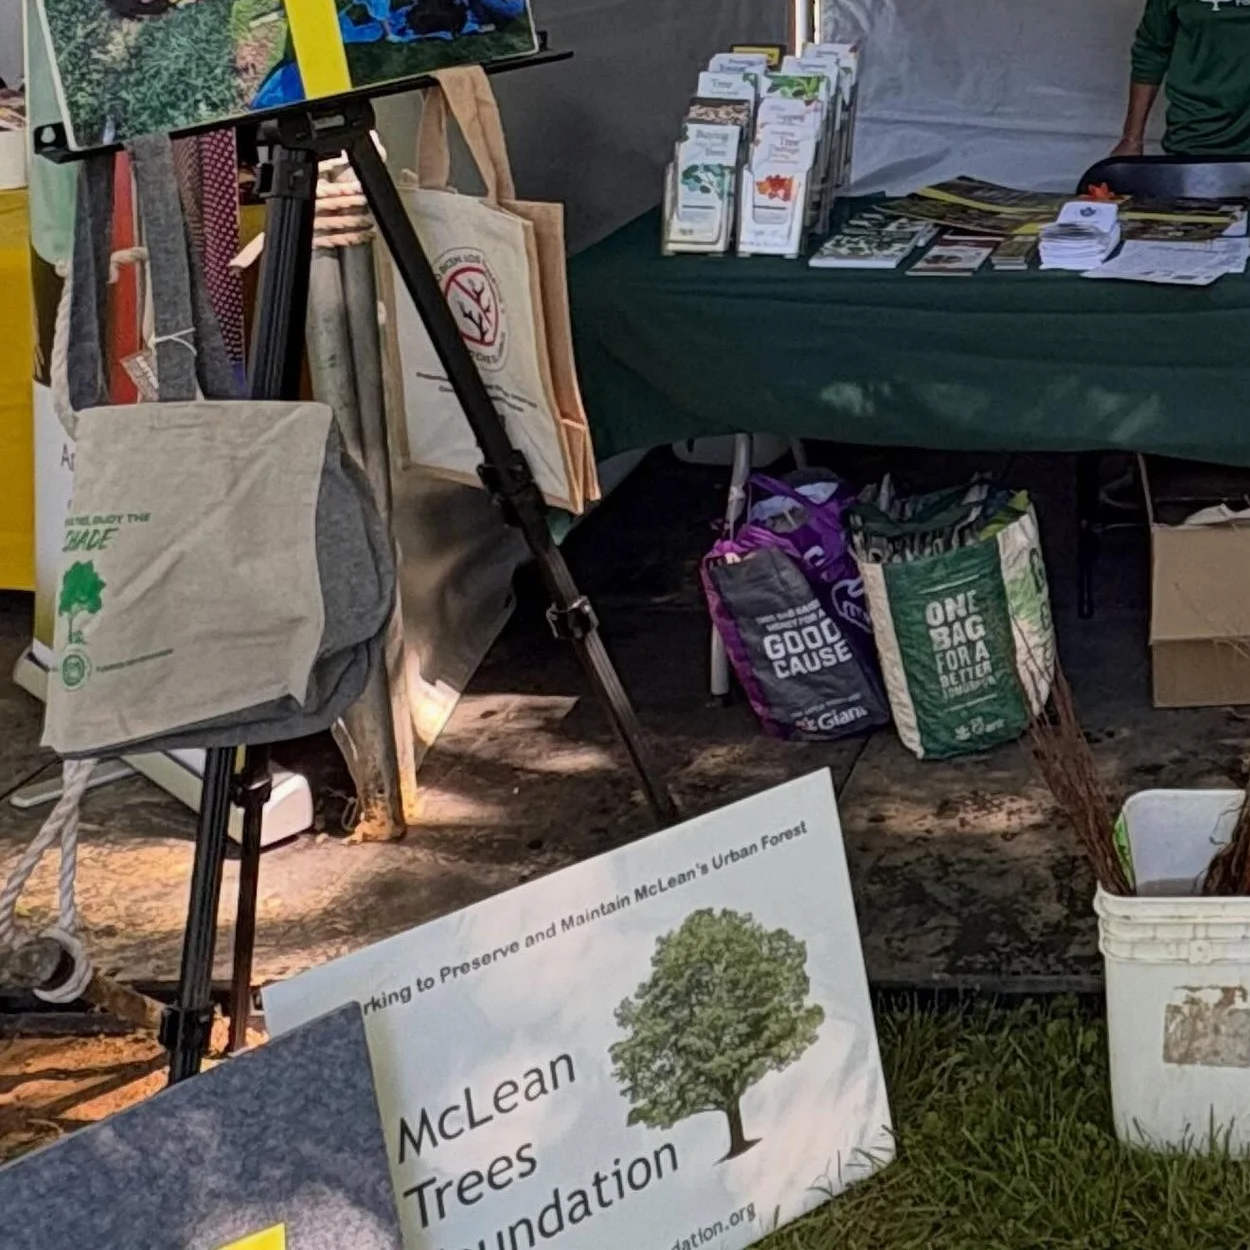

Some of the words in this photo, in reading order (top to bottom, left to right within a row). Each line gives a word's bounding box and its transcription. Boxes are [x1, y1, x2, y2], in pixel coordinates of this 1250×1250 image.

[925, 589, 980, 627] ONE
[763, 617, 842, 660] GOOD
[928, 614, 987, 651] BAG
[773, 638, 853, 679] CAUSE
[934, 645, 971, 674] FOR
[975, 639, 990, 662] A
[363, 985, 412, 1016] rking
[416, 976, 435, 992] to
[439, 941, 521, 984] Preserve
[525, 922, 557, 949] and
[561, 895, 631, 931] Maintain
[634, 862, 709, 903] McLean's
[711, 841, 759, 870] Urban
[761, 820, 808, 851] Forest
[398, 1052, 576, 1165] McLean
[403, 1142, 538, 1230] Trees
[440, 1141, 680, 1250] undation
